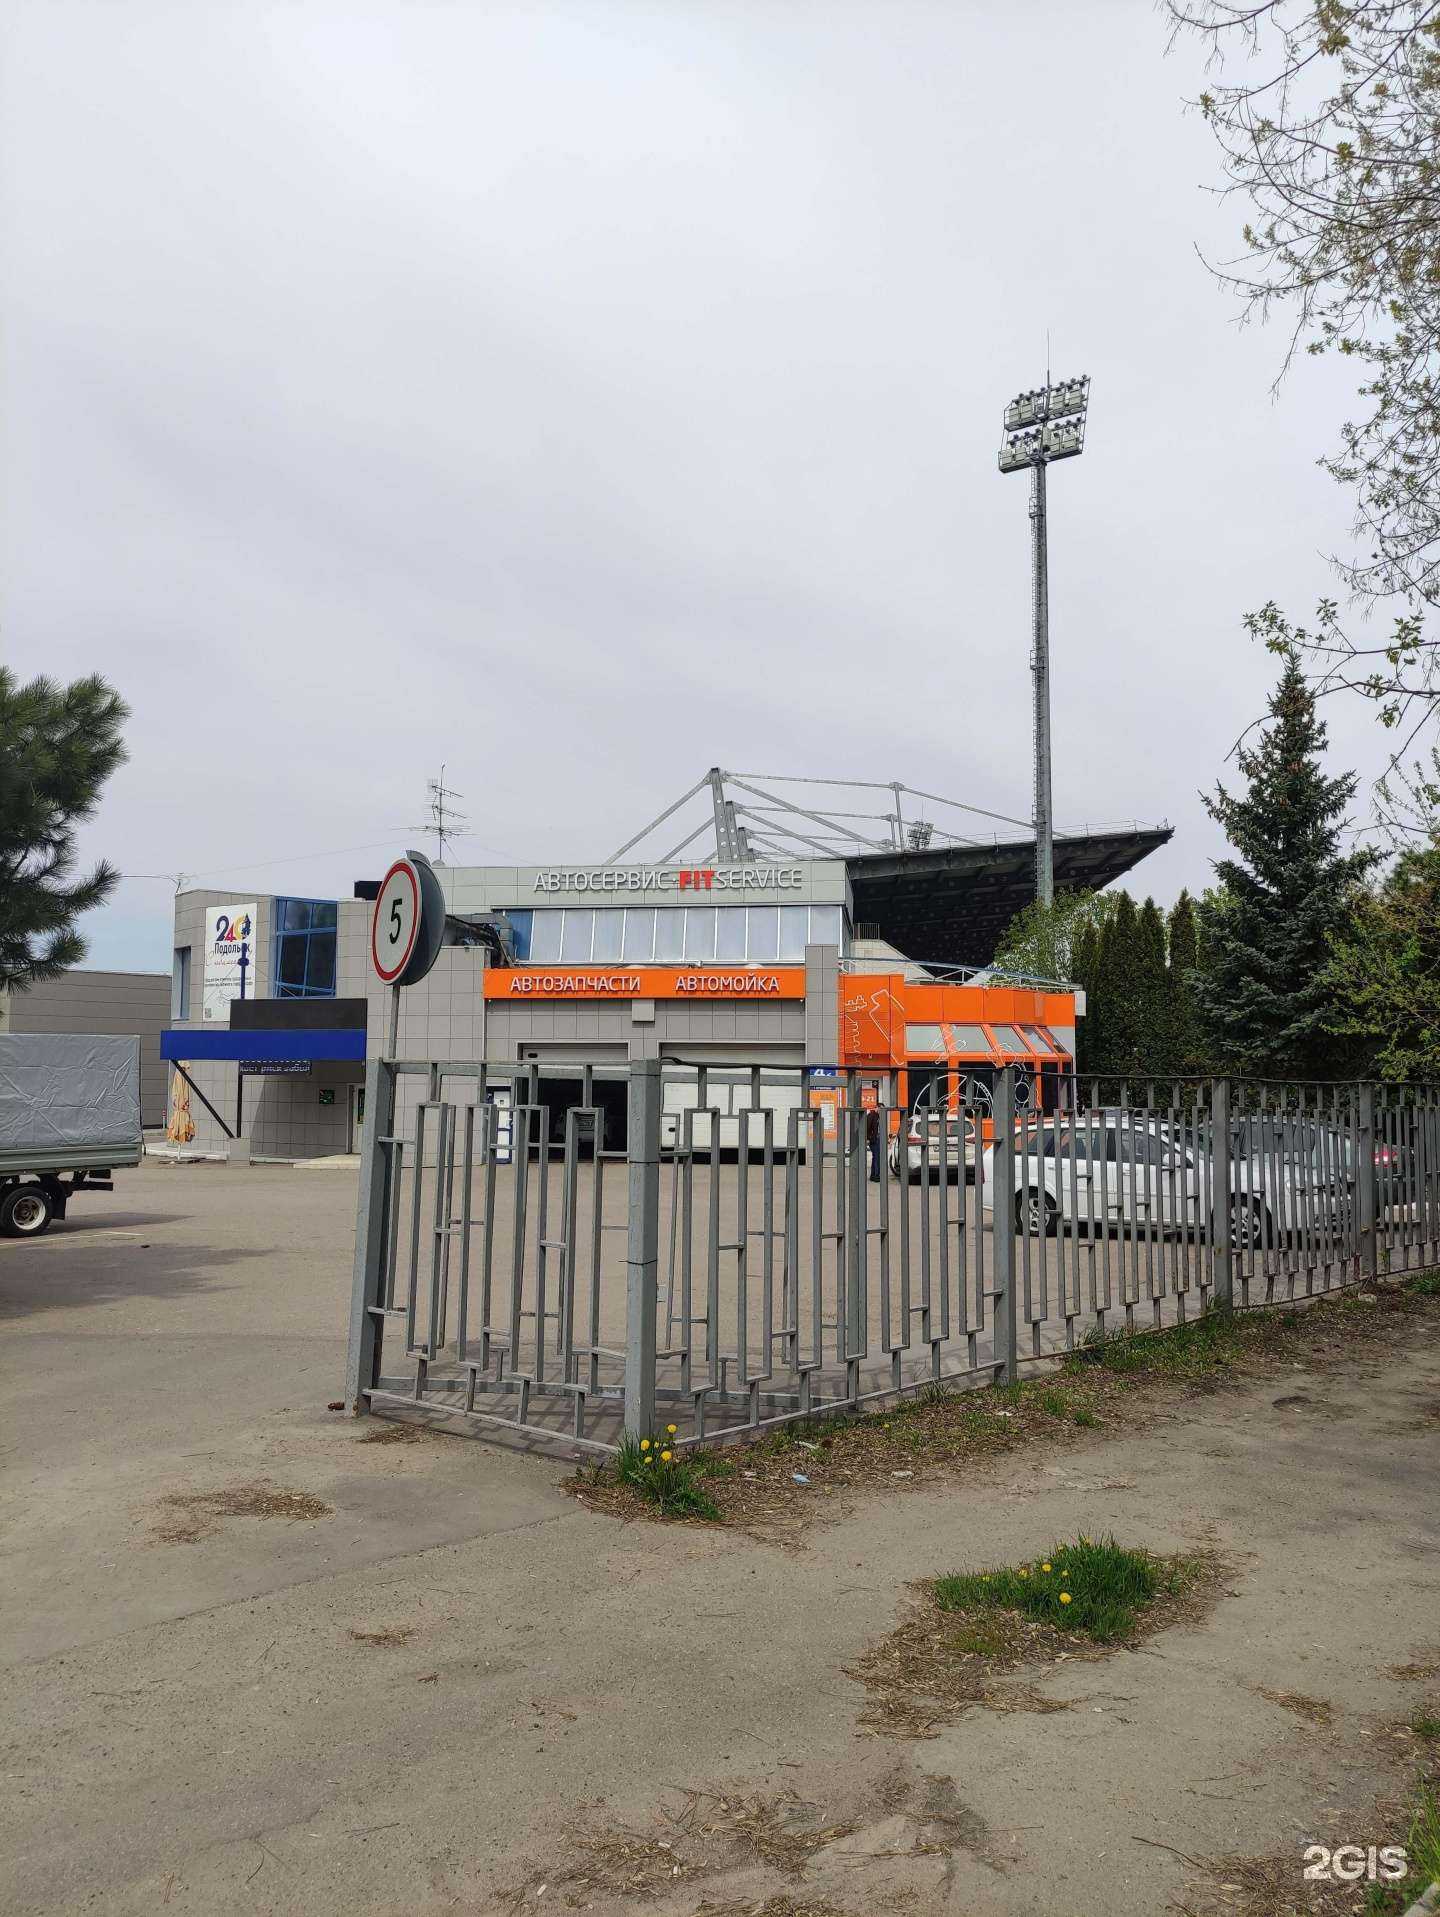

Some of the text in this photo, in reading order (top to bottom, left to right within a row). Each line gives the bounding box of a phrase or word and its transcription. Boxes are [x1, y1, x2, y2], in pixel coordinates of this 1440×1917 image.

[534, 870, 670, 891] АВТОСЕРВИС
[389, 898, 403, 945] 5
[214, 942, 251, 955] Подольк
[510, 973, 780, 992] АВТОЗАПЧАСТИ АВТОМОЙКА
